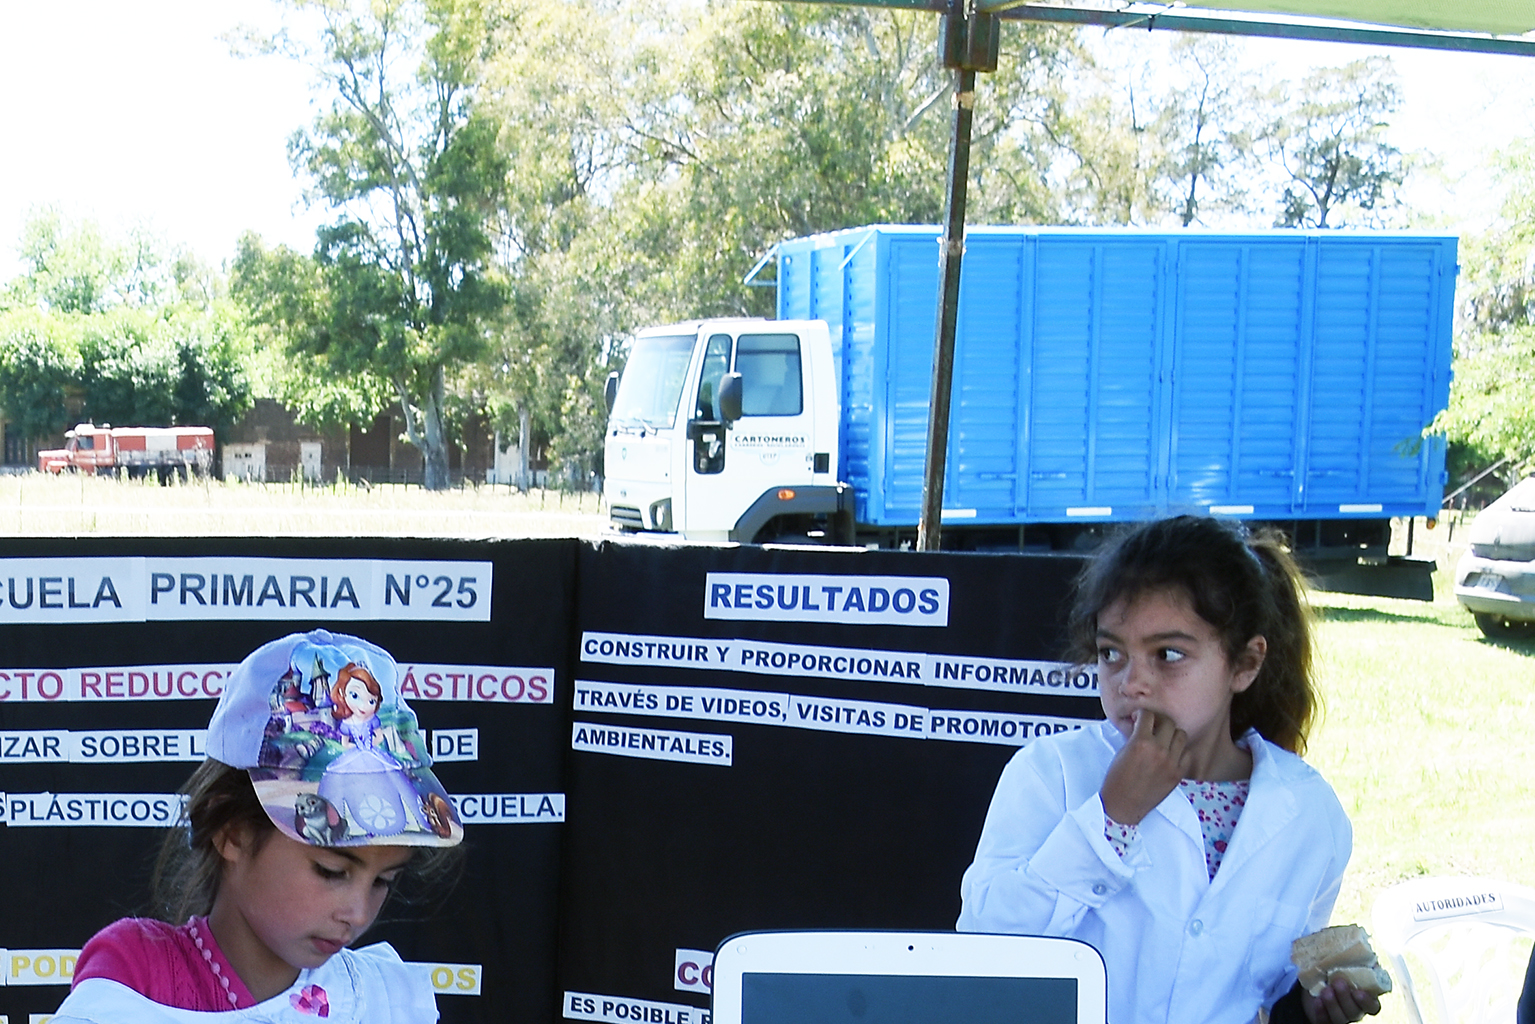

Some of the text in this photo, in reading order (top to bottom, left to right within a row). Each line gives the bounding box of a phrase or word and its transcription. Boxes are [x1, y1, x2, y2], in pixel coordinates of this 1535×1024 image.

[150, 573, 361, 609] PRIMARIA
[384, 573, 479, 609] N°25
[710, 583, 940, 615] RESULTADOS
[584, 638, 708, 662] CONSTRUIR
[716, 646, 730, 663] Y
[741, 649, 921, 679] PROPORCIONAR
[81, 671, 231, 698] REDUCC
[400, 666, 548, 701] ÁSTICOS
[577, 689, 658, 710] TRAVÉS
[666, 694, 693, 712] DE
[701, 697, 787, 722] VIDEOS,
[797, 703, 885, 728] VISITAS
[894, 713, 923, 732] DE
[81, 735, 179, 758] SOBRE
[436, 735, 474, 756] DE
[574, 728, 731, 758] AMBIENTALES.
[10, 794, 169, 822] PLÁSTICOS
[449, 796, 563, 818] CUELA.
[1416, 892, 1496, 914] AUTORIDADES
[11, 954, 76, 978] POD
[431, 966, 476, 990] OS
[570, 996, 596, 1014] ES
